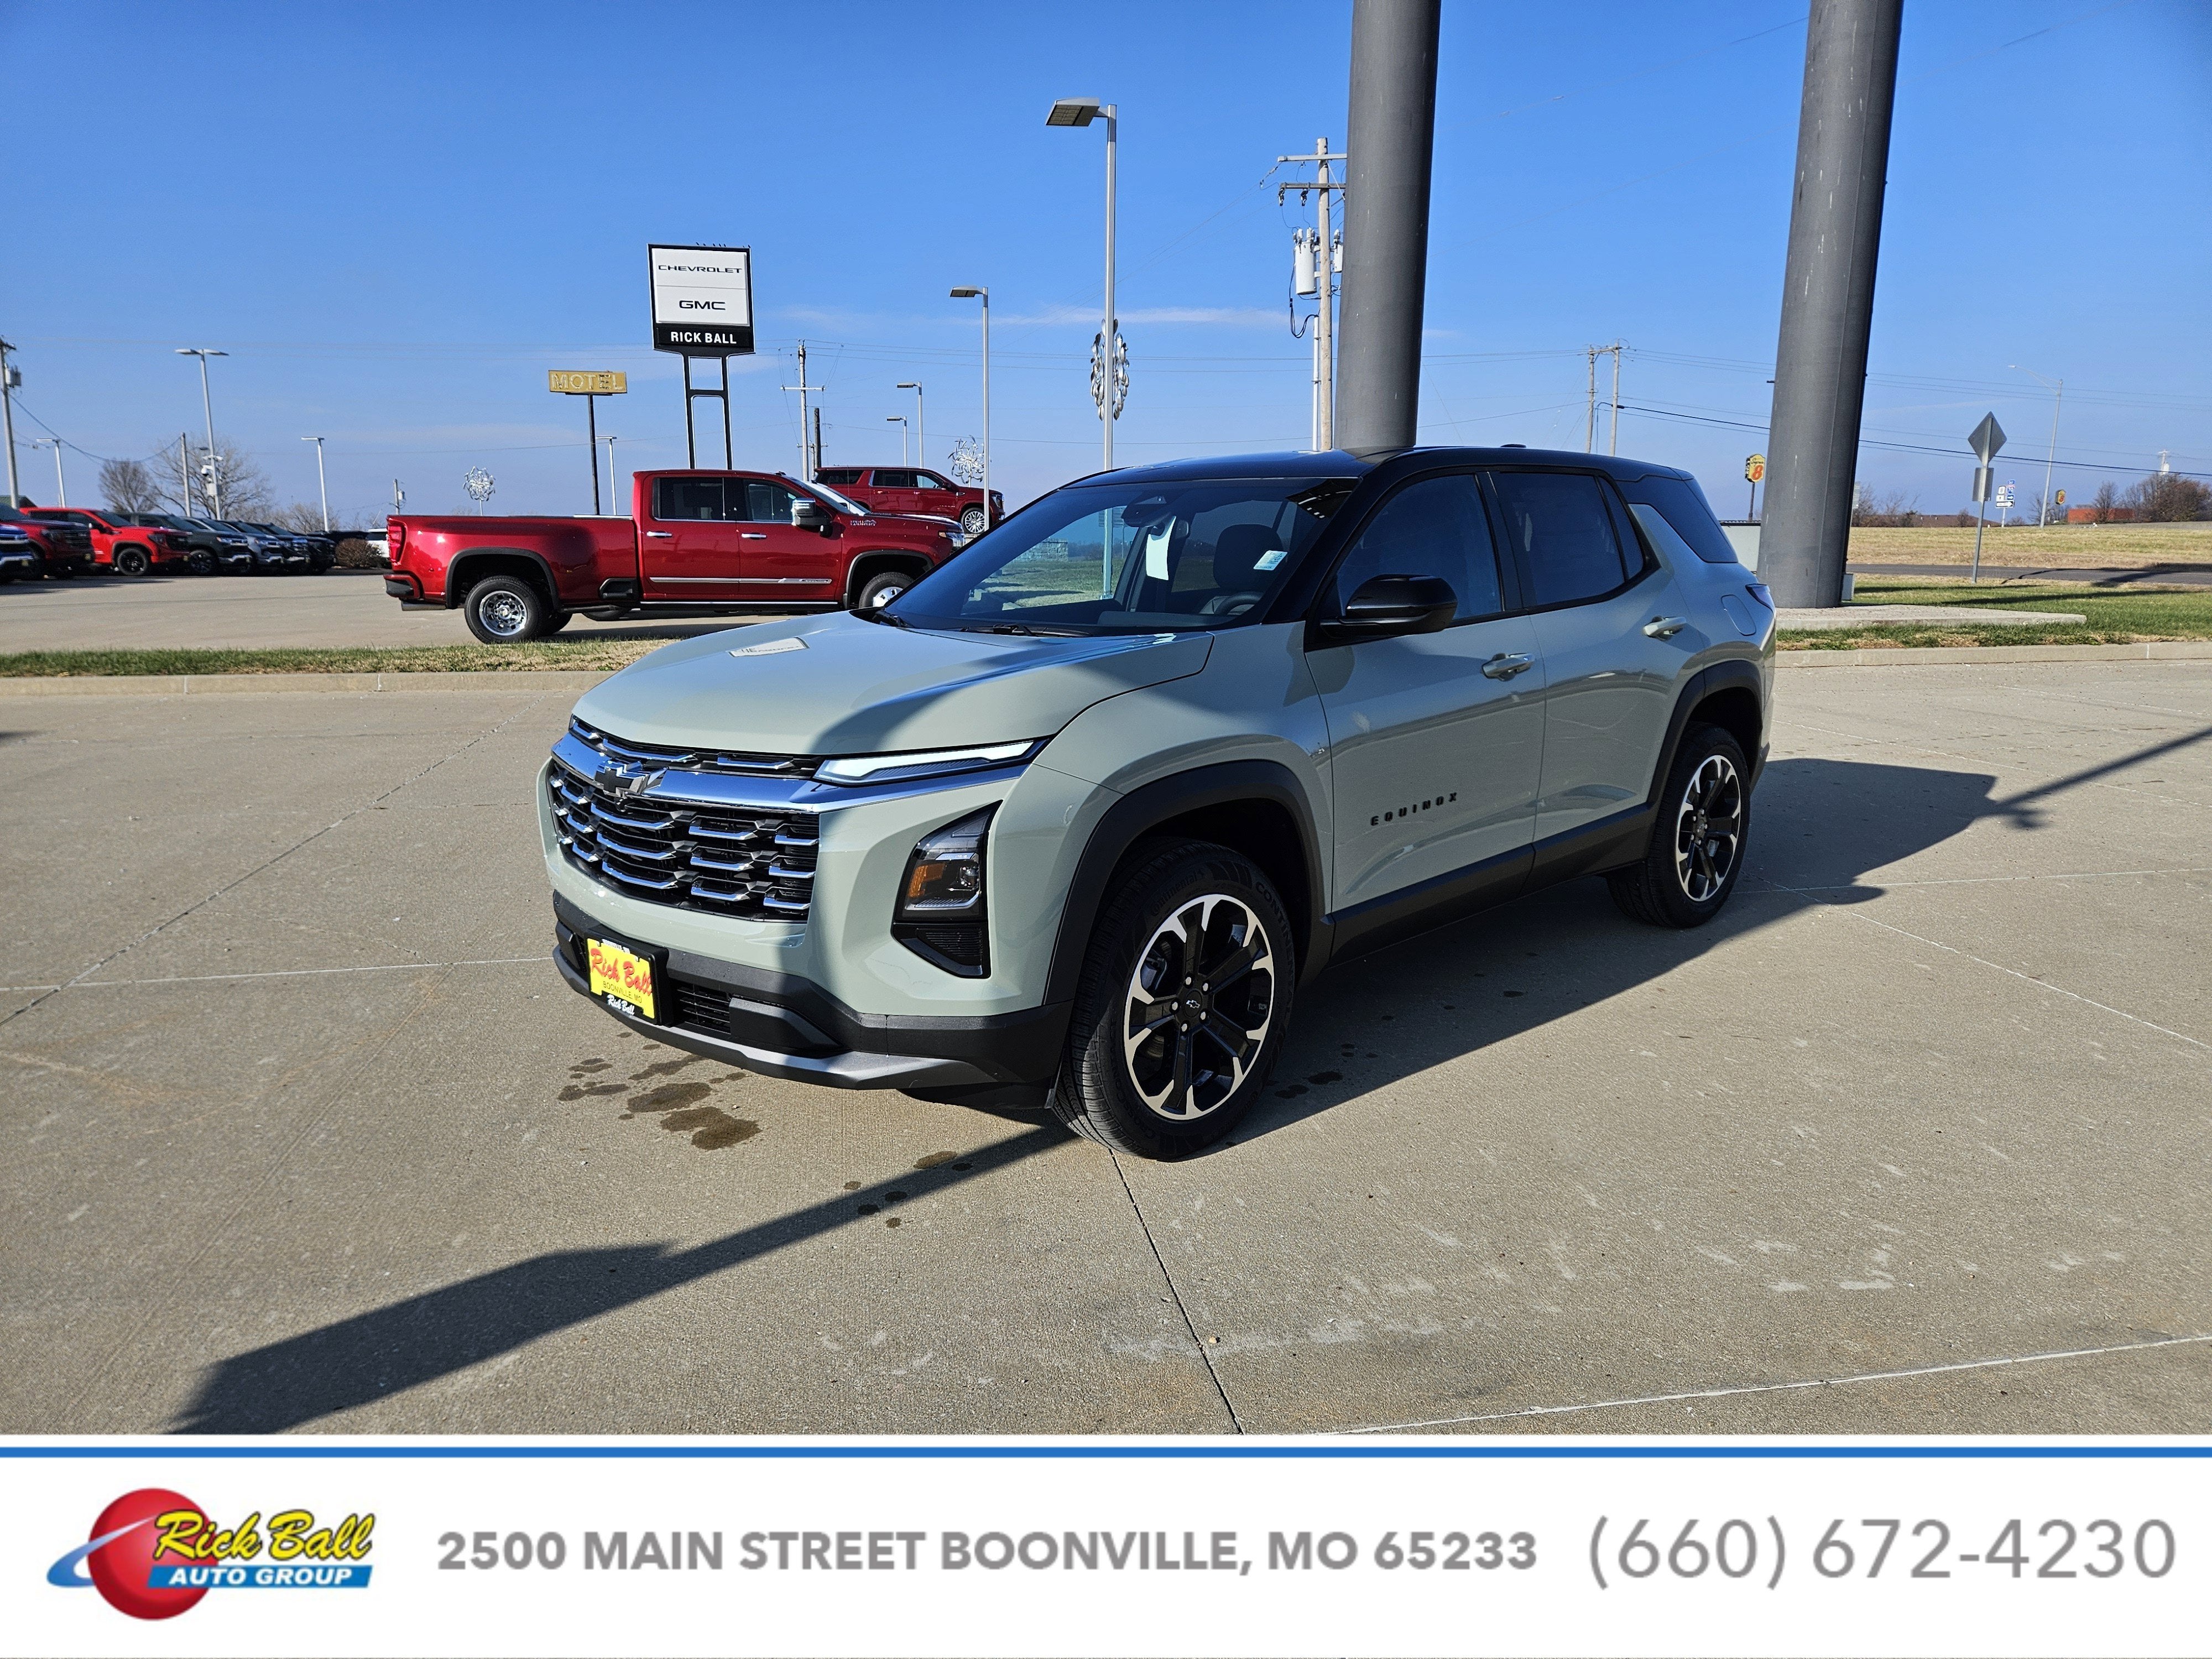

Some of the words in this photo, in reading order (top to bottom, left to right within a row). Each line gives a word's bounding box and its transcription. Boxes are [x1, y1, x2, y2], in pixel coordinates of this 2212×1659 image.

[658, 265, 742, 273] CHEVROLET
[679, 300, 726, 310] GMC
[671, 332, 701, 343] RICK
[705, 333, 737, 344] BALL
[551, 373, 624, 391] MOTEL
[1752, 465, 1763, 480] 8
[1370, 792, 1457, 826] EQUINOX
[1254, 879, 1293, 1015] CONTINENTAL
[590, 948, 620, 983] Rick
[623, 961, 653, 997] Ball
[634, 994, 642, 1003] MO
